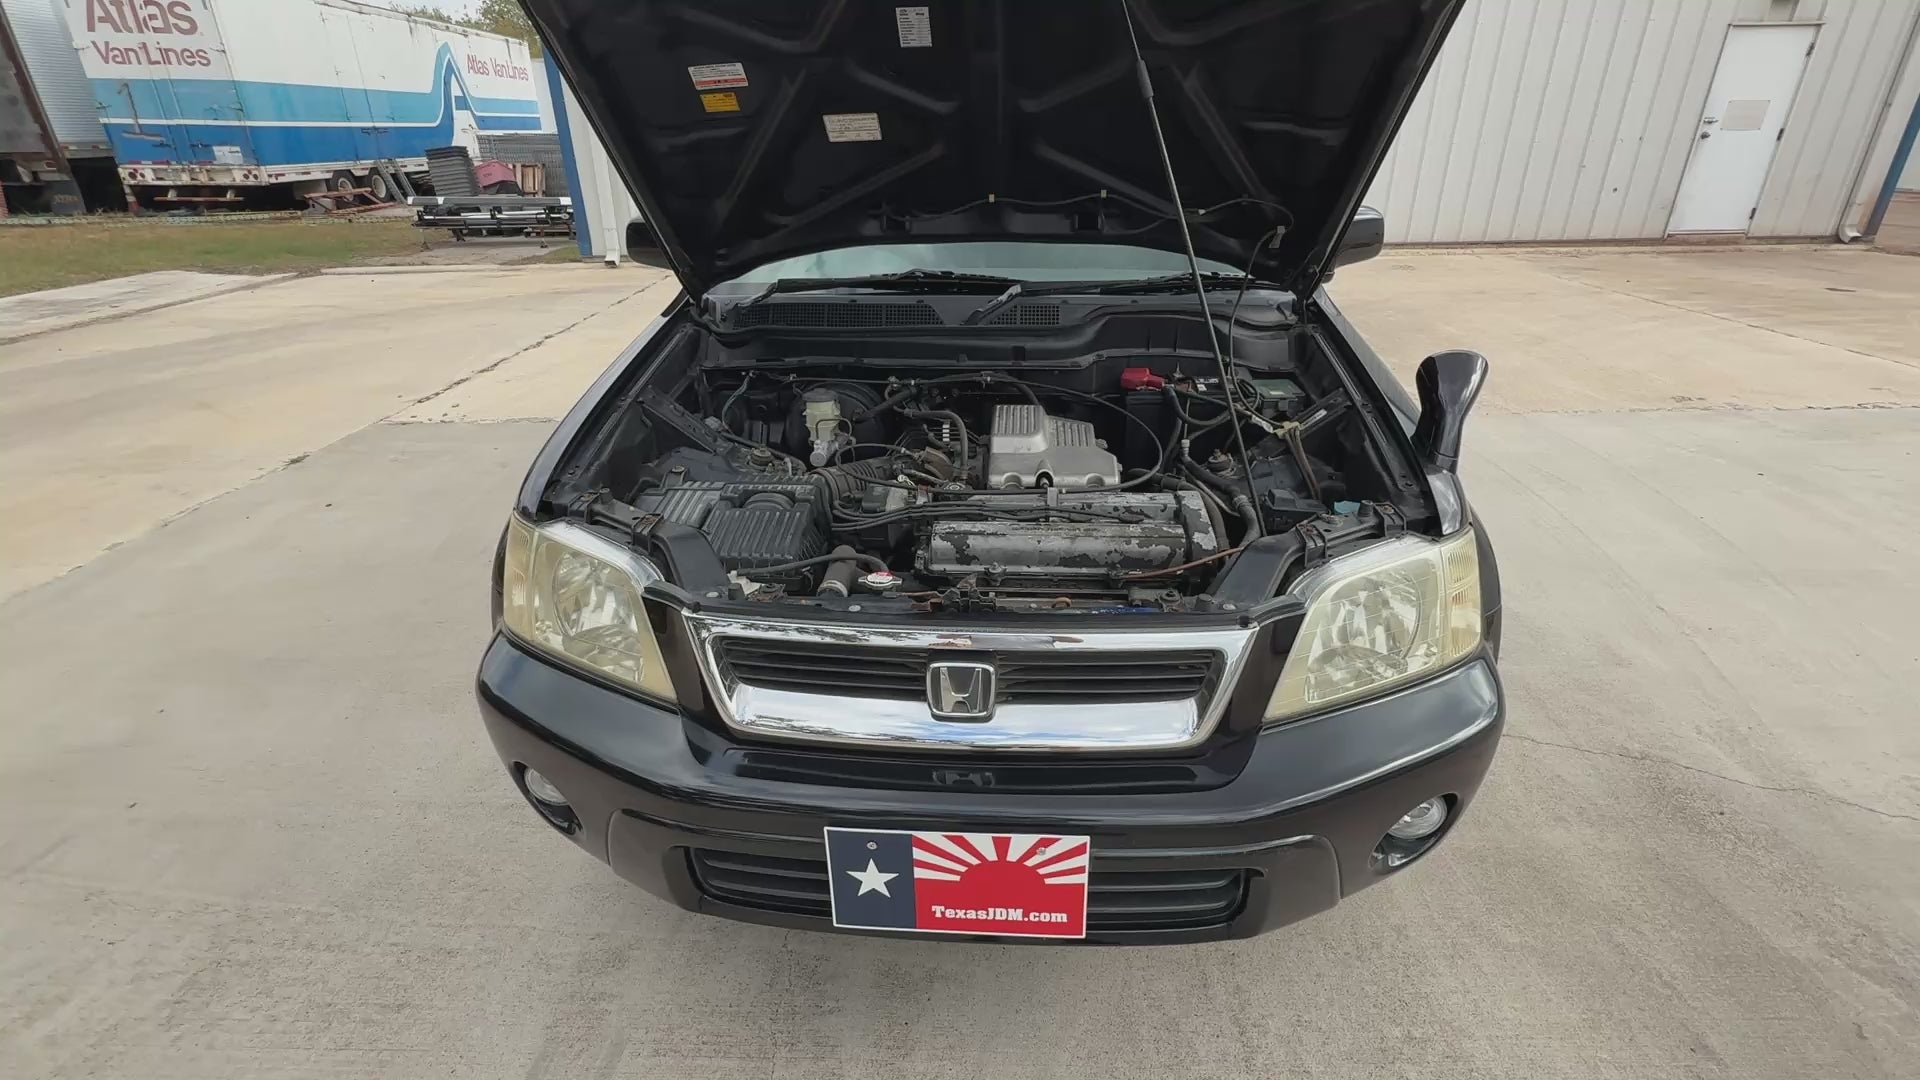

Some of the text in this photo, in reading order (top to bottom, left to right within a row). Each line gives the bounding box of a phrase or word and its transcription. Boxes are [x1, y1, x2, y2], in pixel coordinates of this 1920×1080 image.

[86, 0, 198, 35] Atlas
[467, 54, 489, 76] Atlas
[932, 905, 1067, 923] TexasJDM.com
